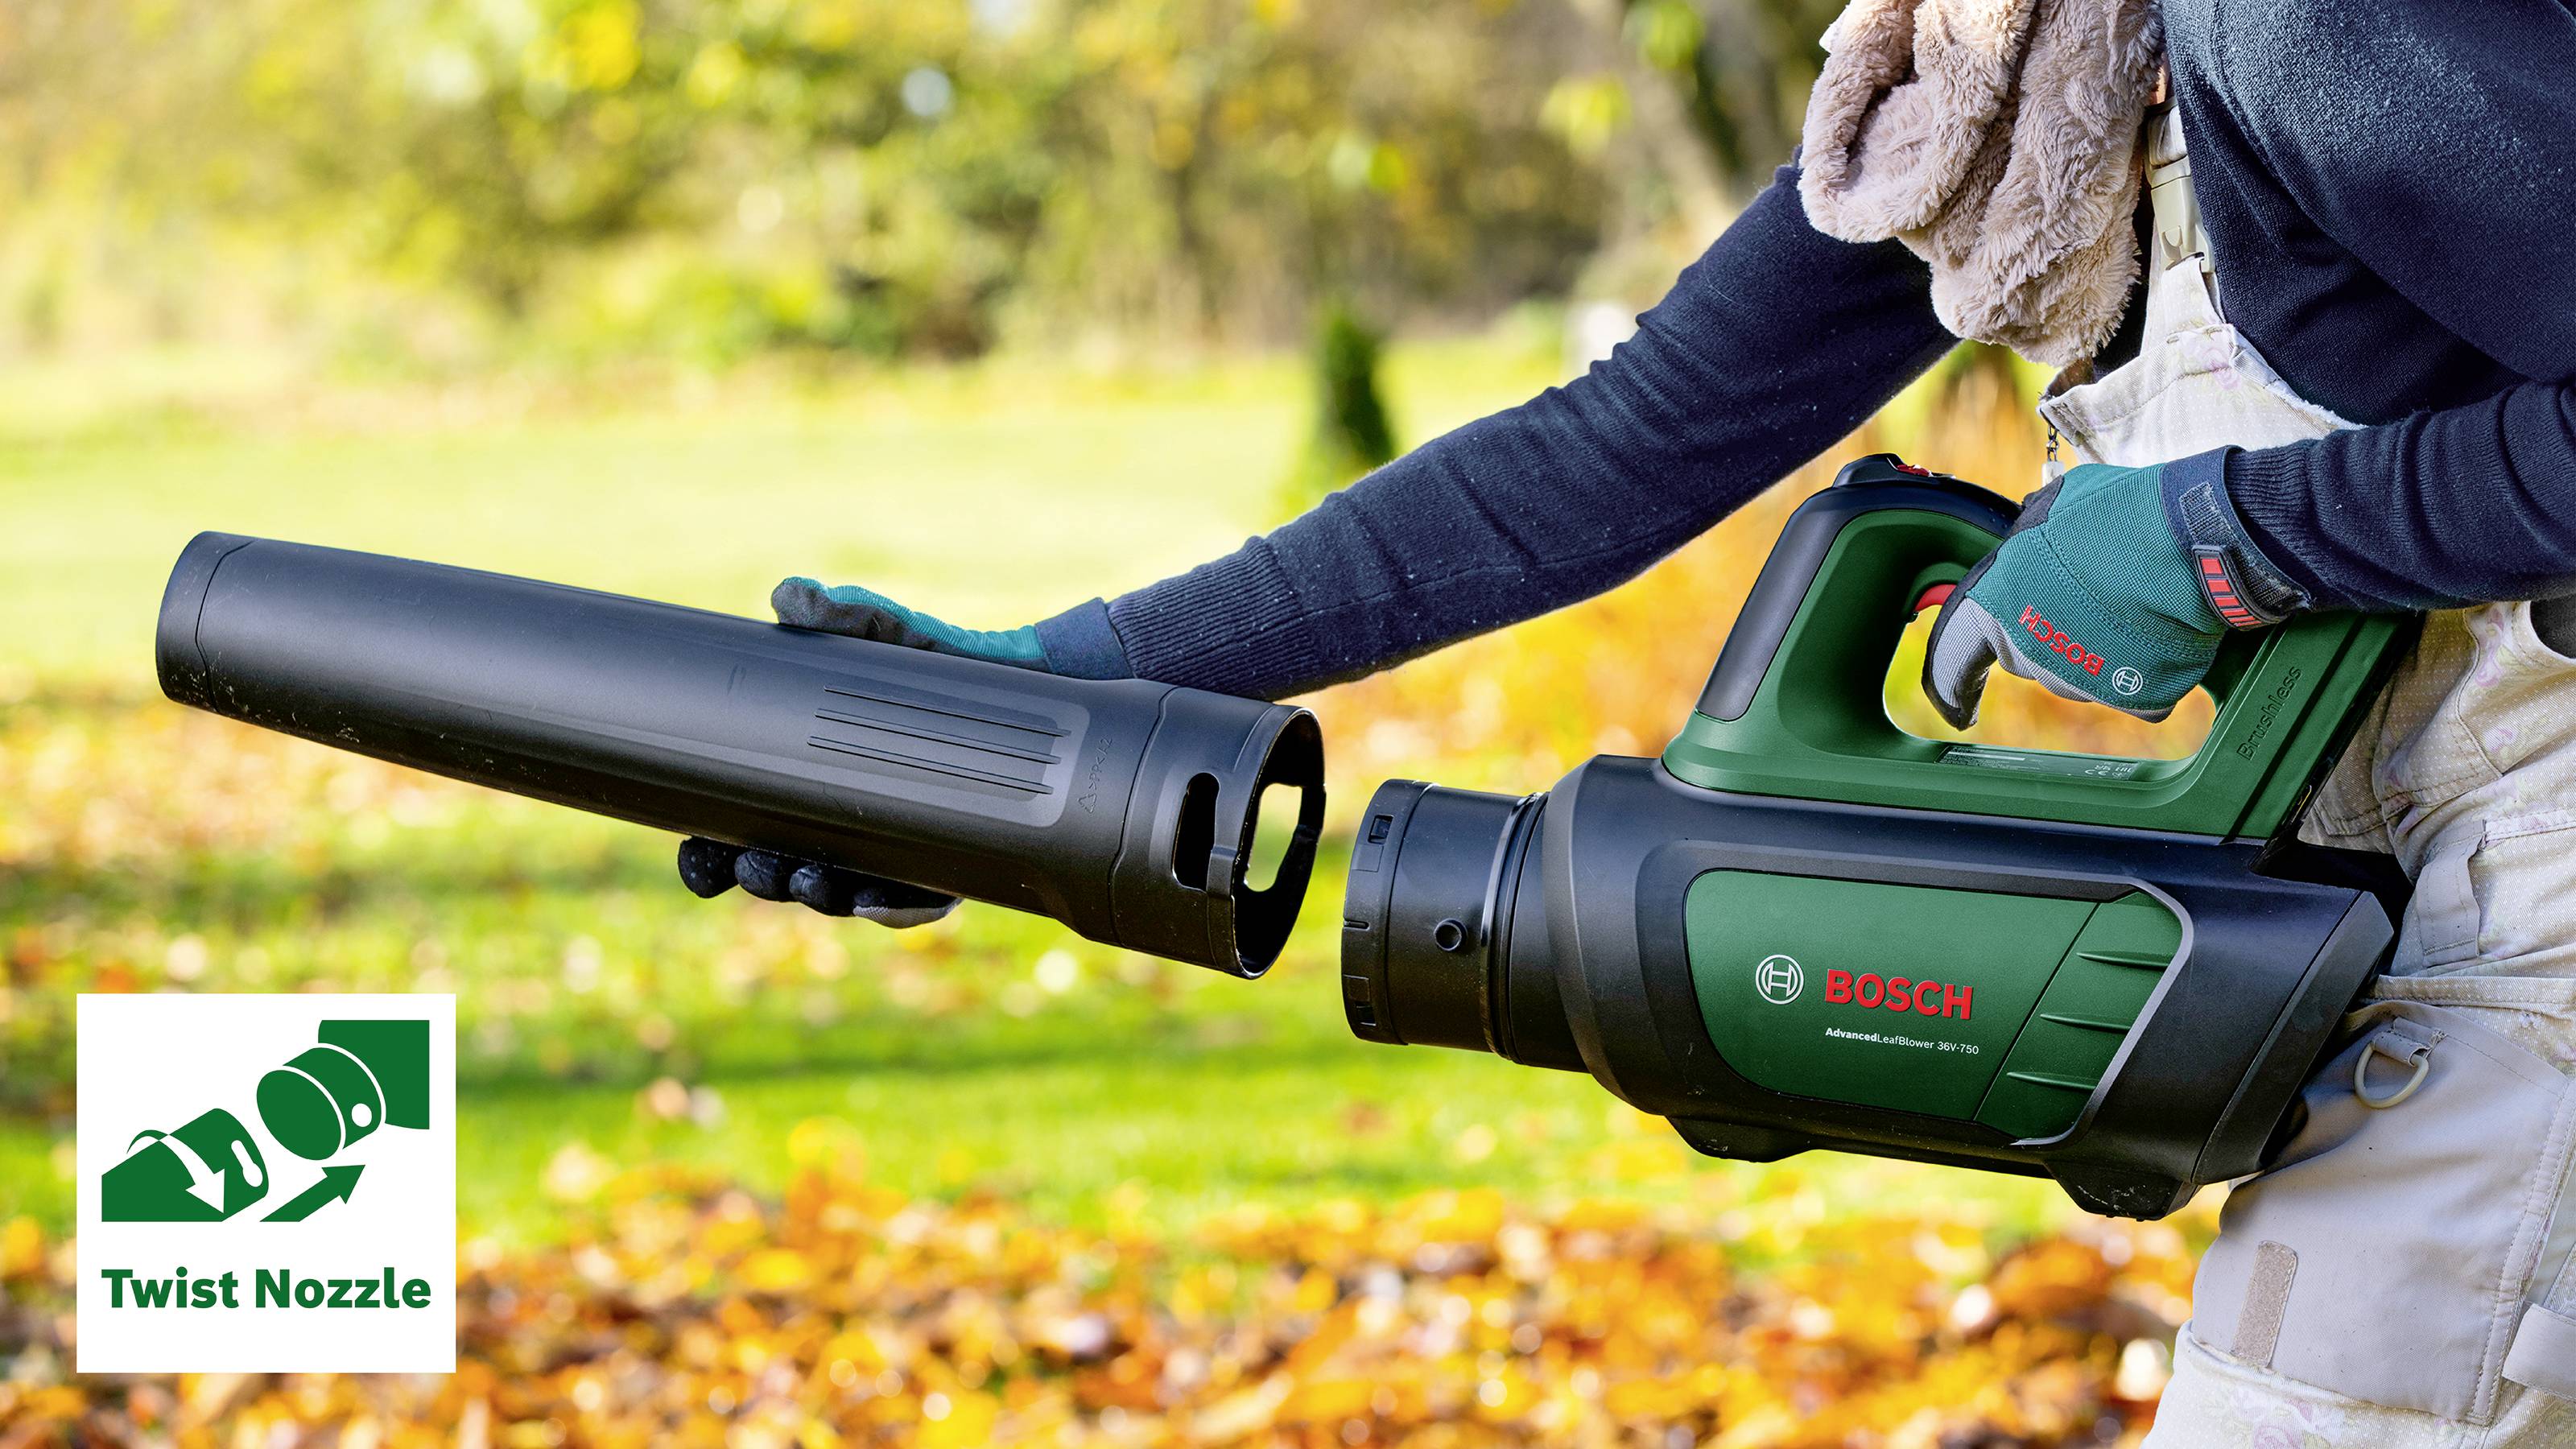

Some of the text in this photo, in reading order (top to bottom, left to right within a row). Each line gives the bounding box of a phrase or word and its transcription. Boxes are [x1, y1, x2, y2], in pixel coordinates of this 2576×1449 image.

[2018, 605, 2105, 676] BOSCH
[2236, 665, 2304, 762] Brushless
[1825, 968, 1973, 1021] BOSCH
[1826, 1026, 1979, 1055] AdvancedLeafBlower 36V-750
